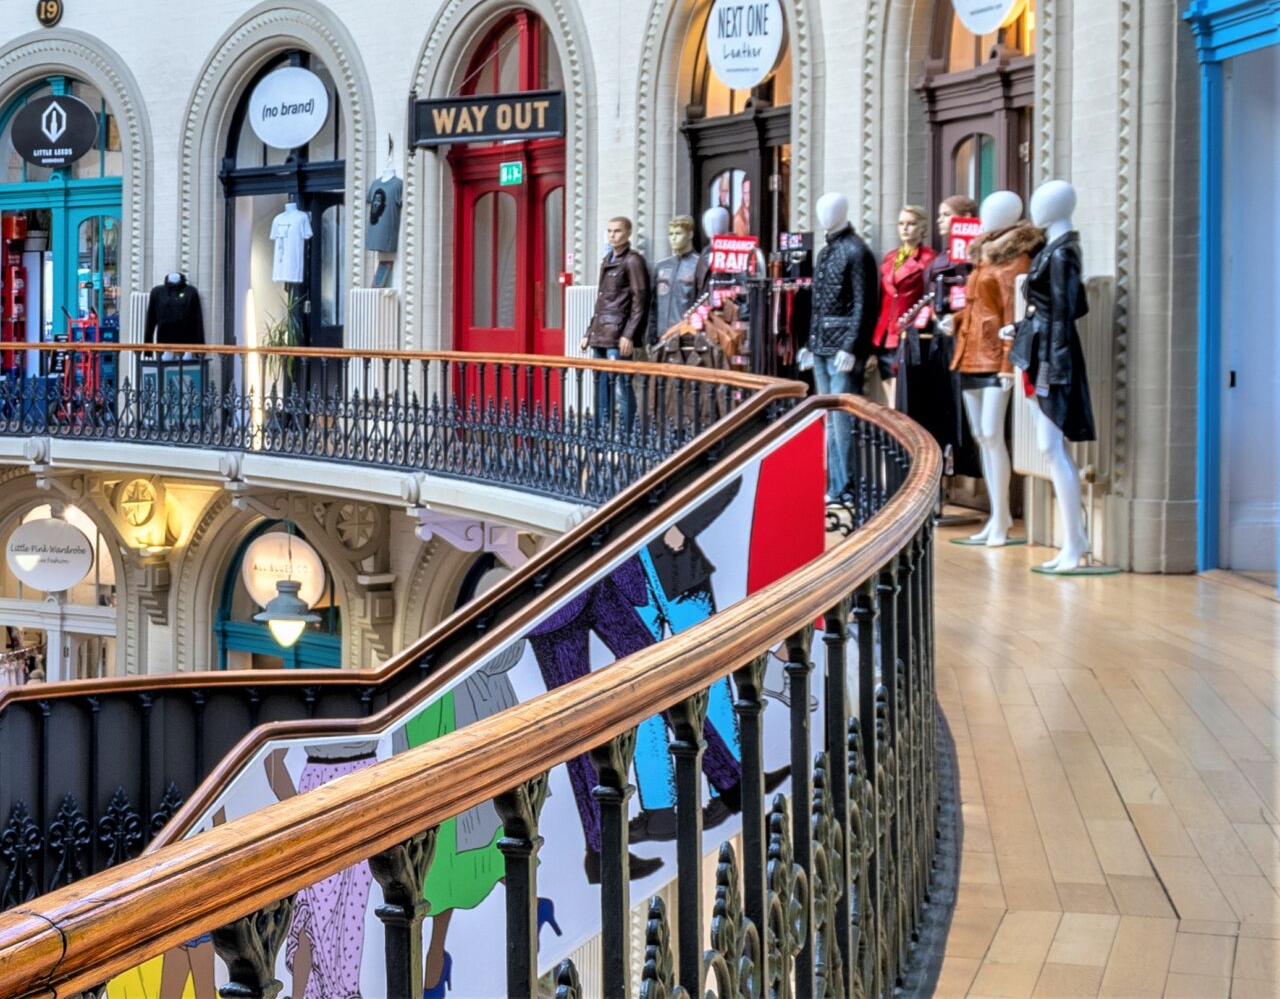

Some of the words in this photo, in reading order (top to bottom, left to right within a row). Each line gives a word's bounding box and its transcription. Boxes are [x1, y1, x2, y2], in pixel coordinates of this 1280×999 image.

[39, 0, 58, 19] 19
[718, 5, 744, 39] NEXT
[747, 4, 770, 36] ONE
[723, 42, 762, 60] Leather
[262, 104, 278, 121] (no
[280, 98, 315, 116] brand)
[432, 105, 489, 135] WAY
[496, 101, 550, 131] OUT
[33, 149, 53, 157] LITTLE
[54, 148, 73, 156] LEEDS
[952, 222, 984, 235] CLEARA
[714, 239, 757, 250] CLEARANCE
[10, 543, 29, 553] Little
[49, 544, 87, 555] Wardrobe
